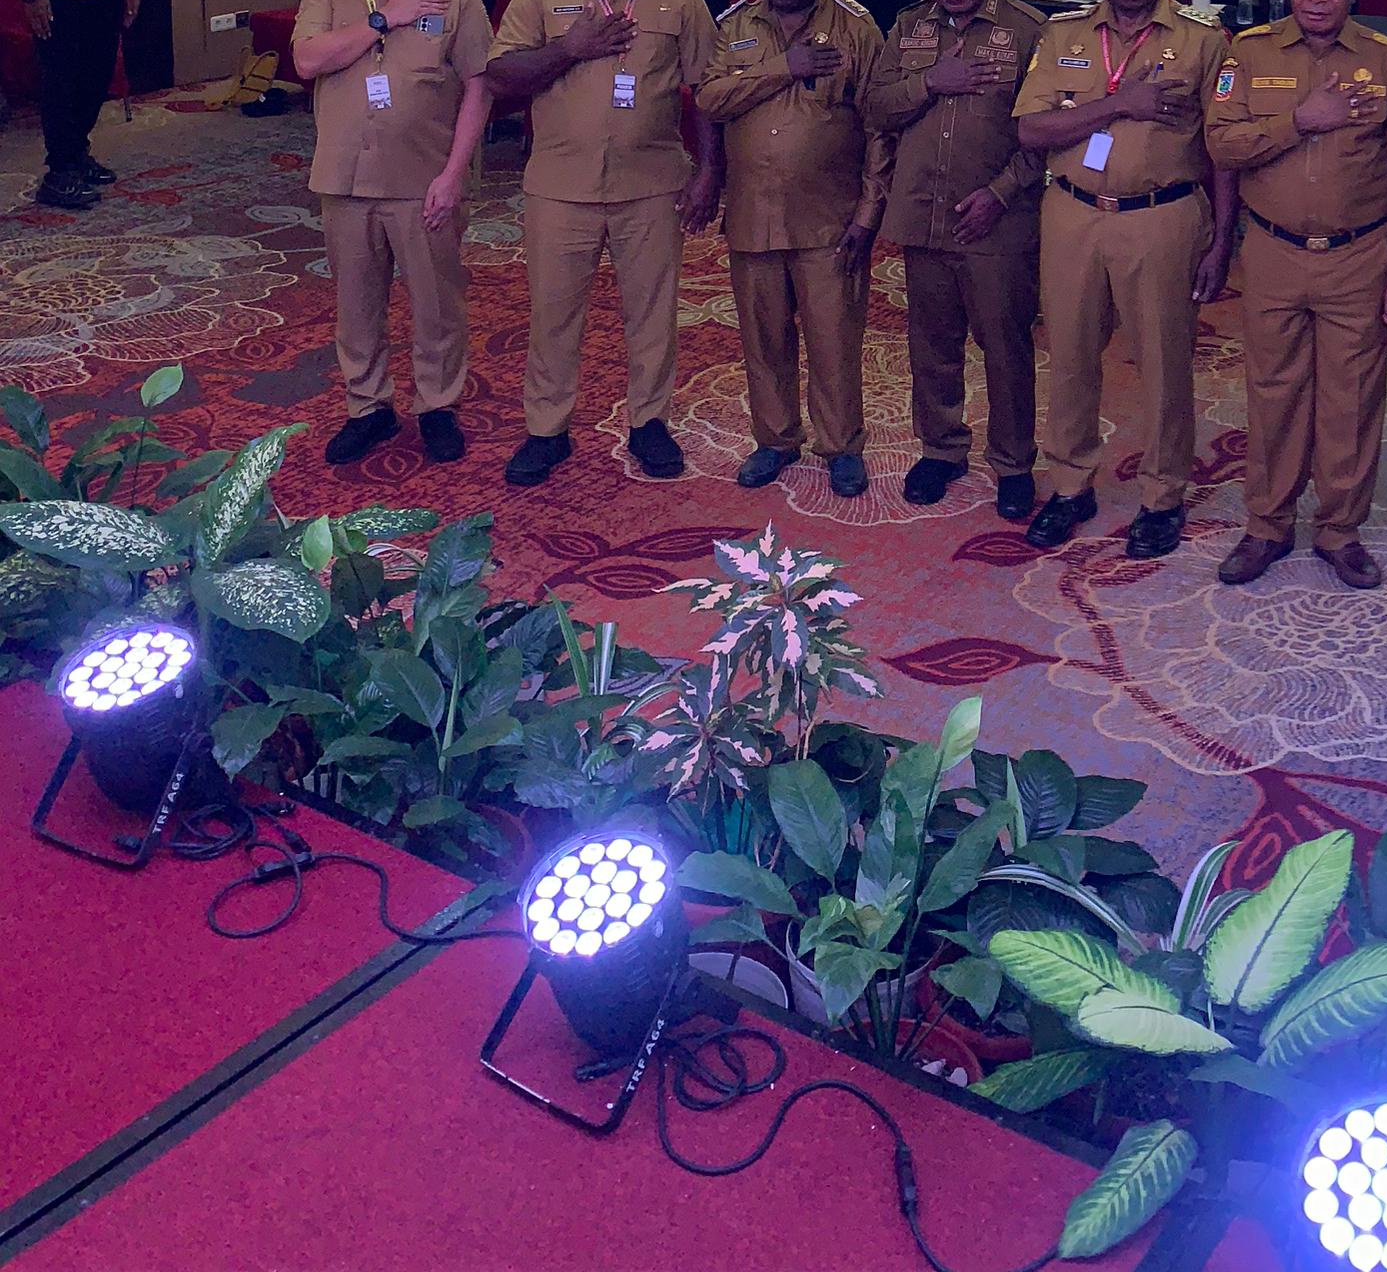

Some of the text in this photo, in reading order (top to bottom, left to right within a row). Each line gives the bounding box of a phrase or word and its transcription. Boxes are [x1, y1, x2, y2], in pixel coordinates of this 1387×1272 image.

[152, 804, 169, 834] TRF
[625, 1018, 665, 1093] TRF A64
